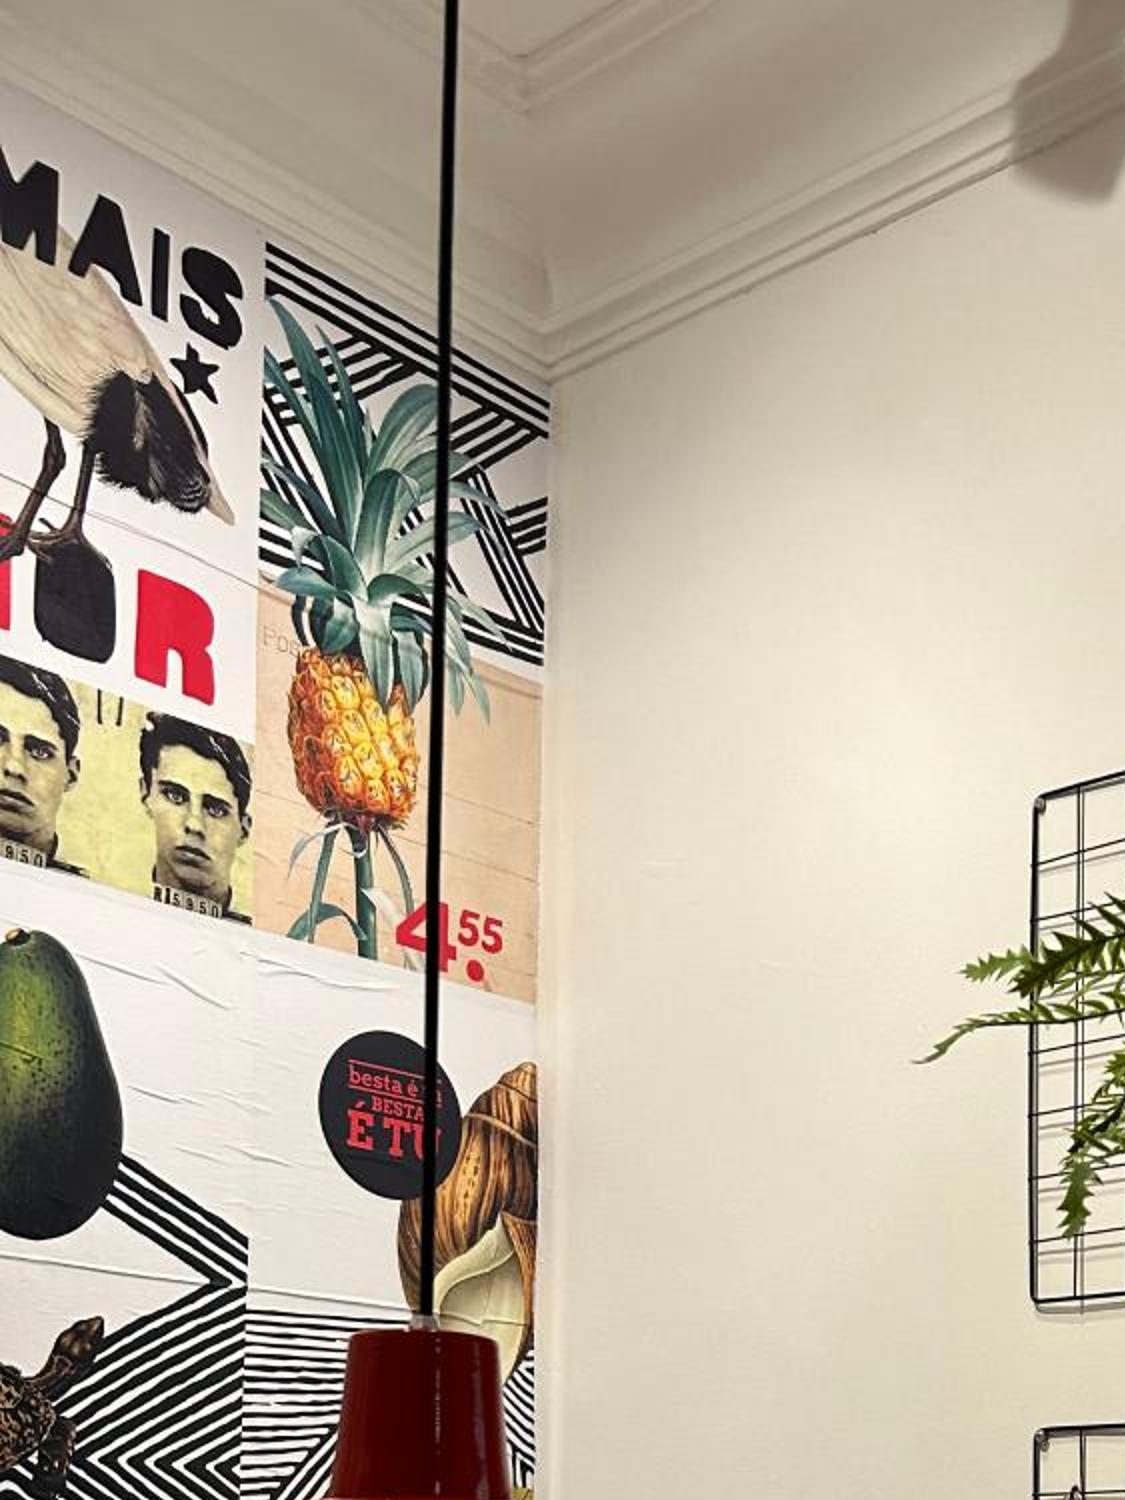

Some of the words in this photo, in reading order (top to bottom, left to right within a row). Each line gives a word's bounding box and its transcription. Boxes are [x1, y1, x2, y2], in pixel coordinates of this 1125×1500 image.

[0, 145, 244, 350] MAIS
[348, 1063, 402, 1096] besta
[346, 1101, 375, 1151] É
[371, 1096, 424, 1121] BESTA
